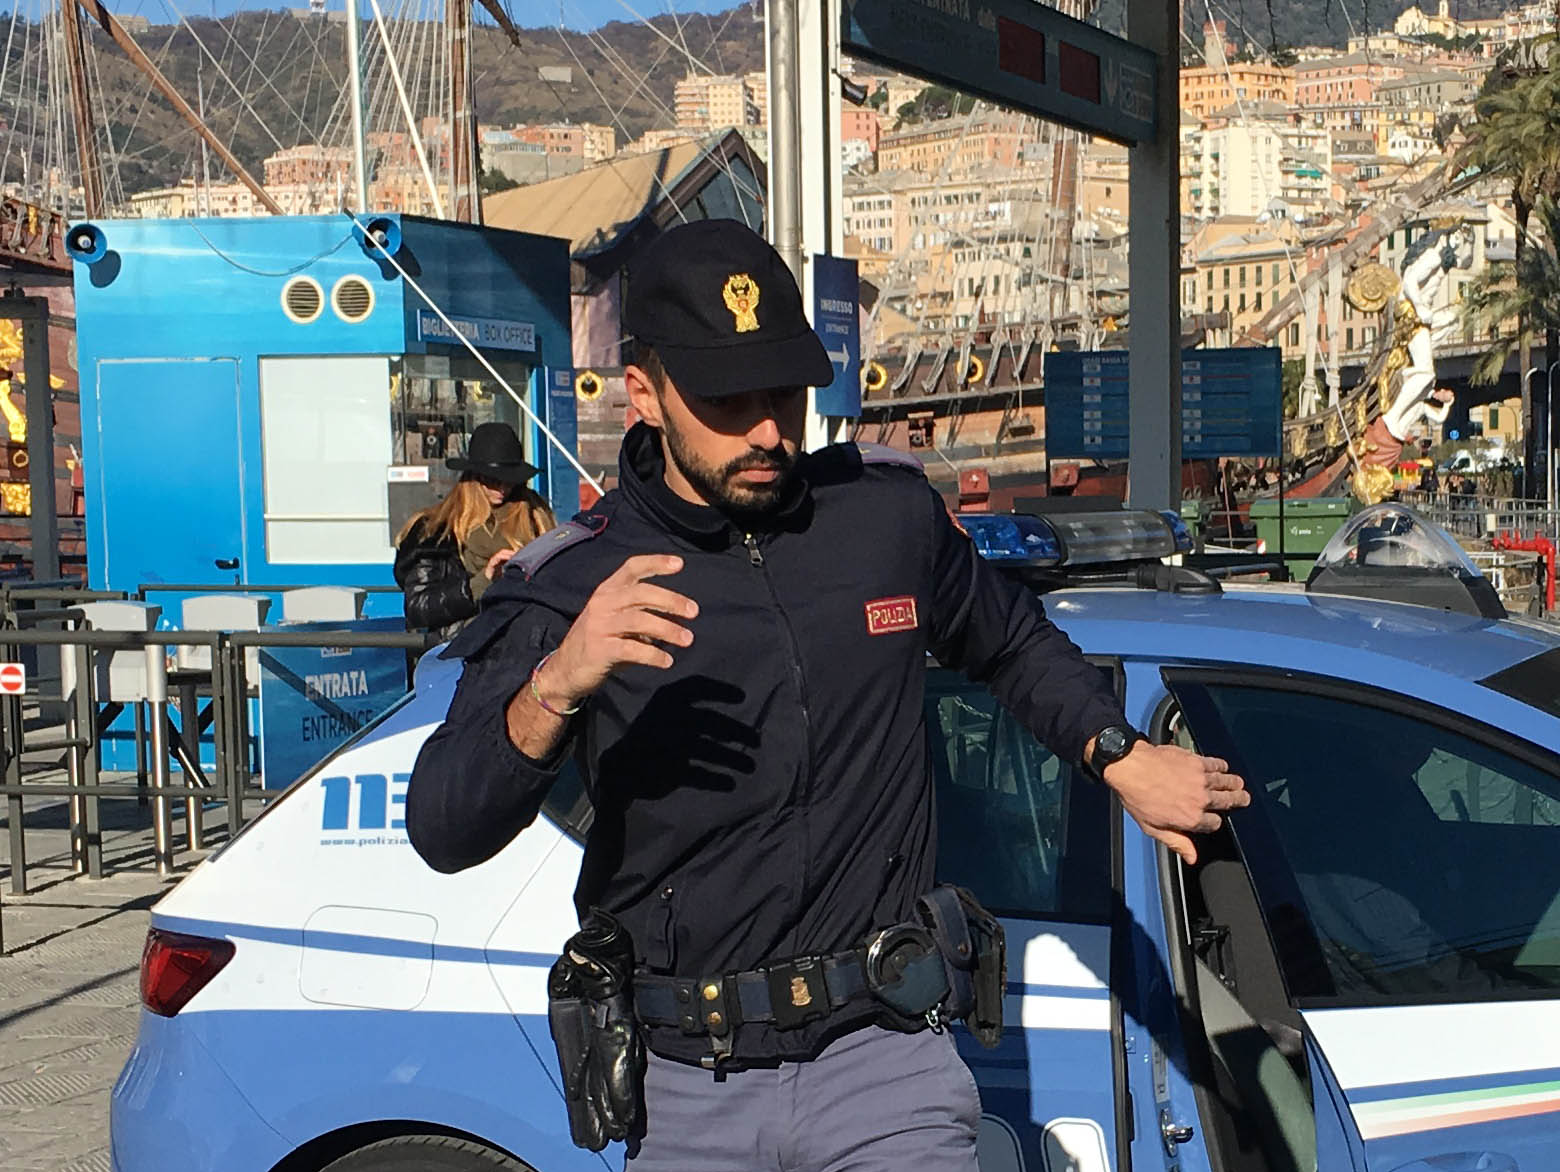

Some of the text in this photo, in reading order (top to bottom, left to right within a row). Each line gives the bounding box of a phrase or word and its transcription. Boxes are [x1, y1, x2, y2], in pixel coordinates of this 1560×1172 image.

[820, 298, 853, 315] INGRESSO
[484, 324, 502, 342] BOX
[504, 326, 533, 346] OFFICE
[873, 606, 913, 627] POLIZIA
[304, 670, 368, 699] ENTRATA
